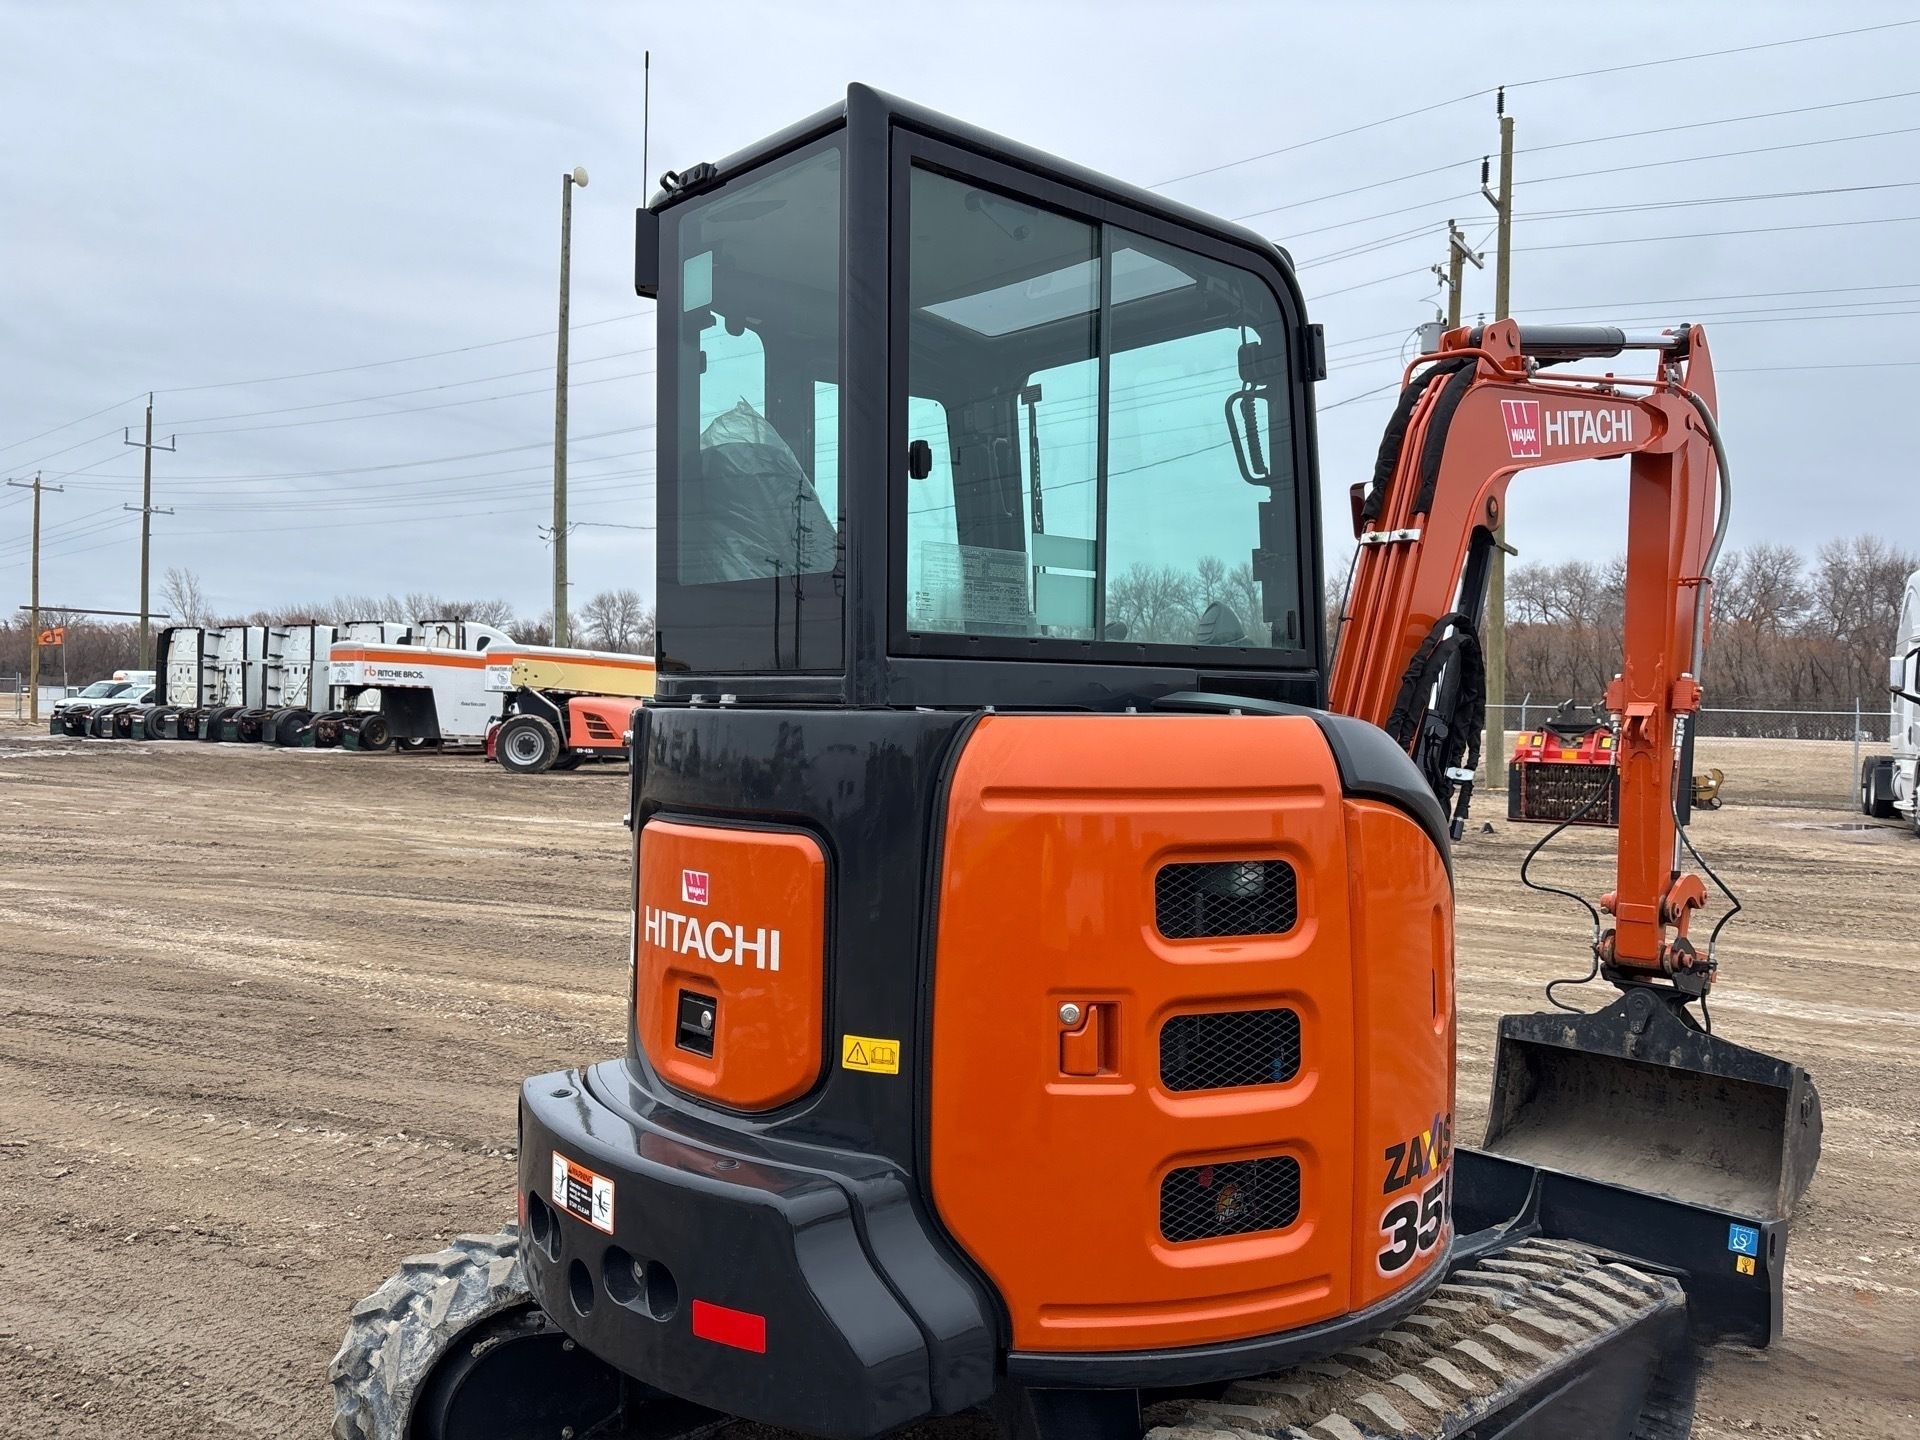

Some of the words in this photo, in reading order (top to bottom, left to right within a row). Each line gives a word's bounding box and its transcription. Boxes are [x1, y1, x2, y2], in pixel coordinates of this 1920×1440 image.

[1545, 409, 1633, 446] HITACHI
[1511, 428, 1536, 445] WAJAX
[364, 665, 377, 677] rb
[377, 669, 402, 678] RITCHIE
[403, 671, 425, 680] BROS.
[688, 885, 706, 897] WAJAX
[645, 905, 780, 972] HITACHI
[1383, 1112, 1451, 1195] ZAXIS
[578, 1204, 590, 1216] CLEAR
